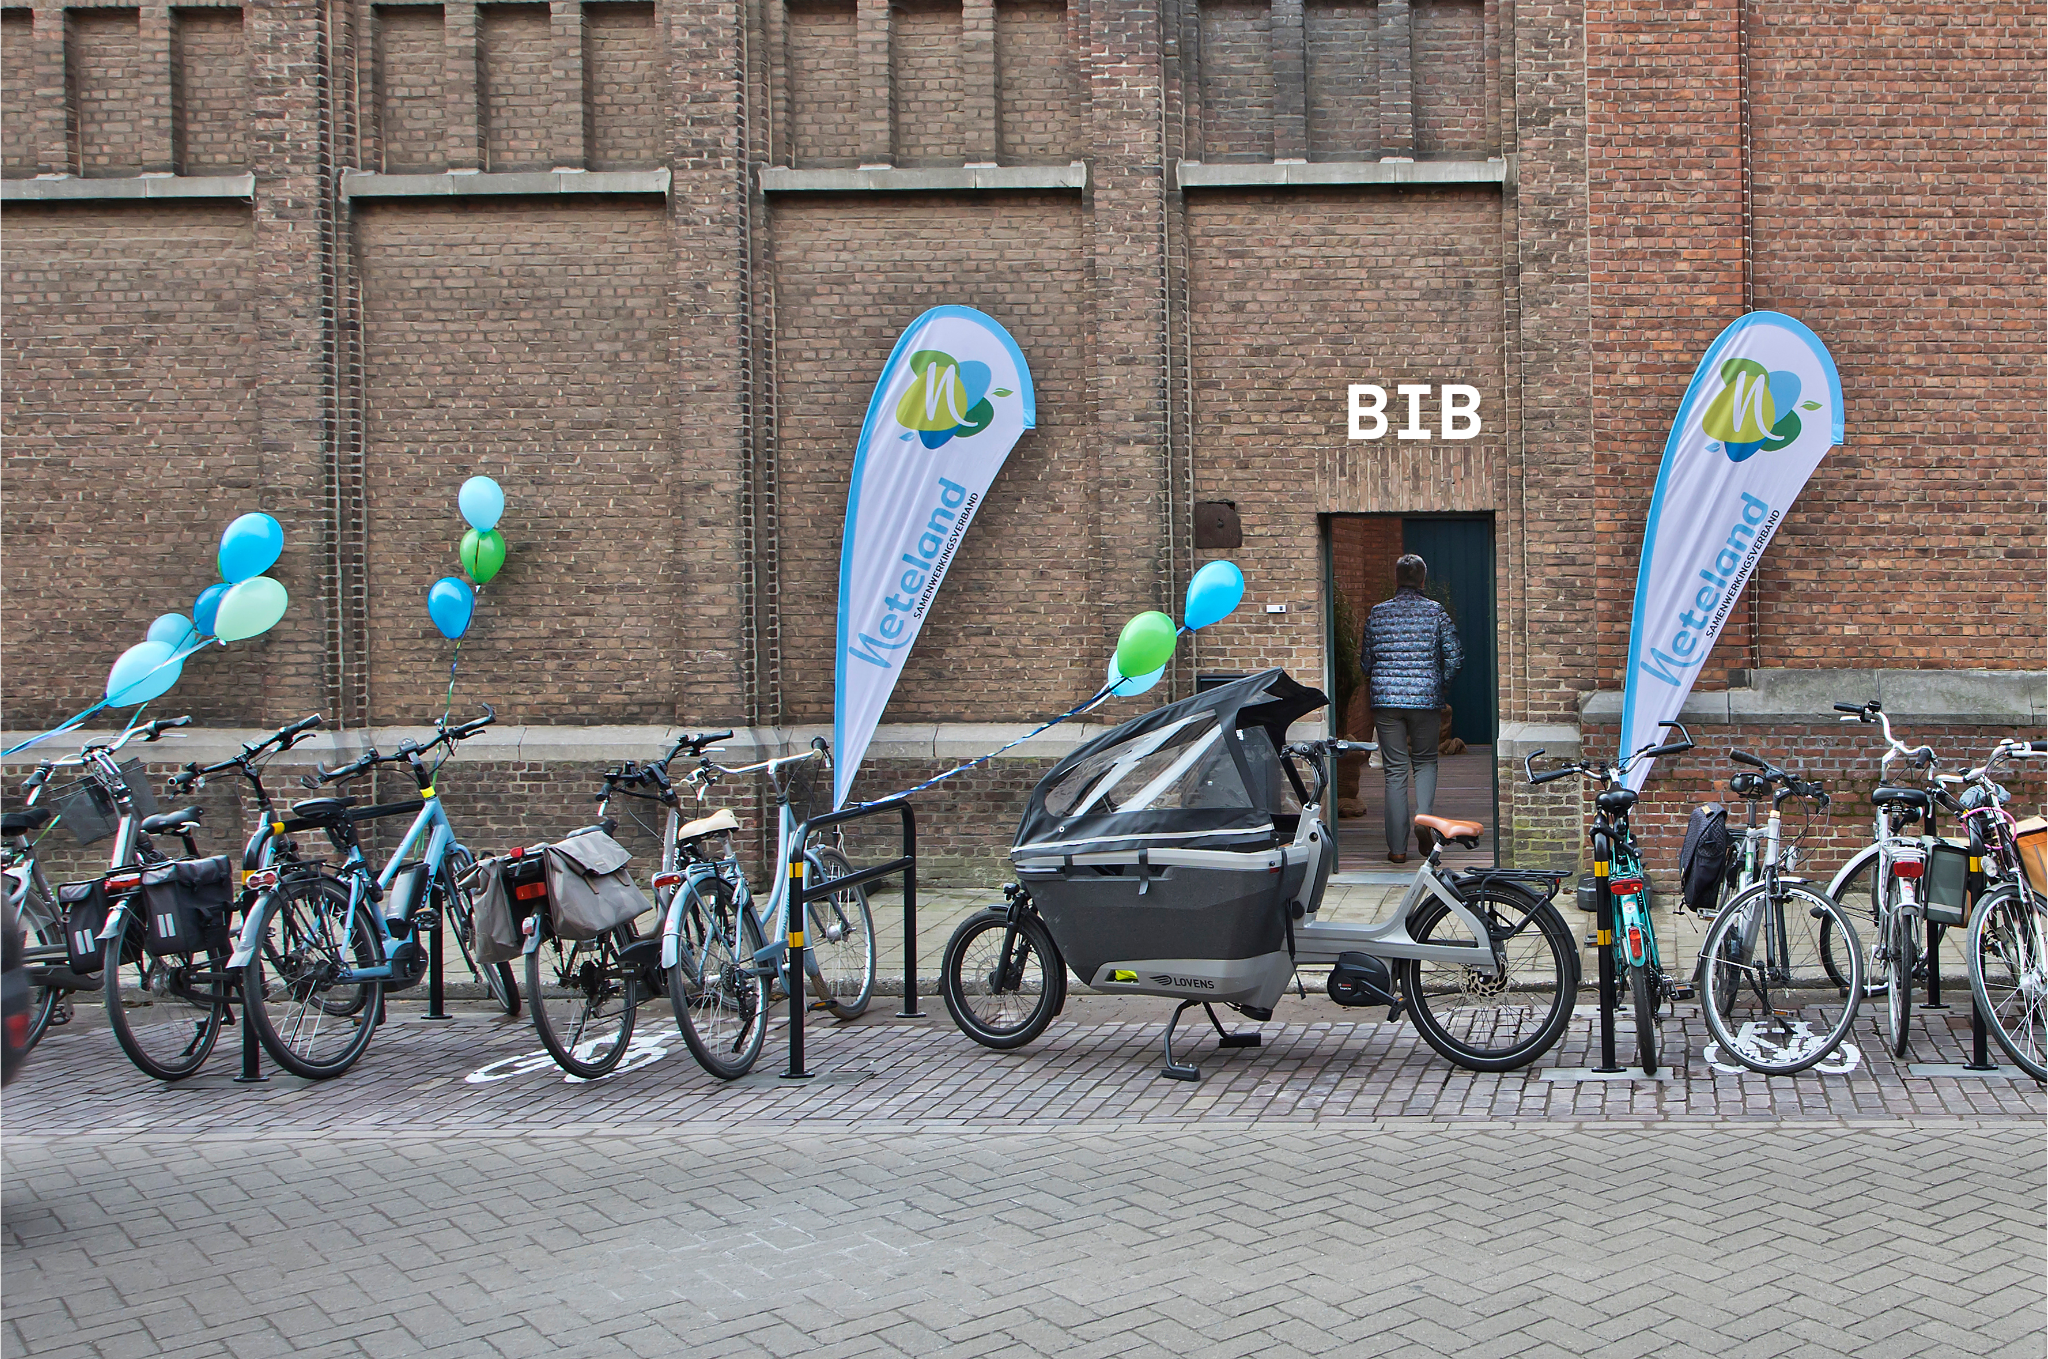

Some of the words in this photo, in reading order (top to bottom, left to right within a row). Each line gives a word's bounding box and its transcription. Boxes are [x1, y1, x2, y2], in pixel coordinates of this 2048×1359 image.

[1348, 384, 1482, 440] BIB
[913, 492, 979, 620] SAMENWERKINGSVERBAND
[1706, 509, 1781, 639] SAMENWERKINGSVERBAND
[1173, 977, 1215, 989] LOVENS
